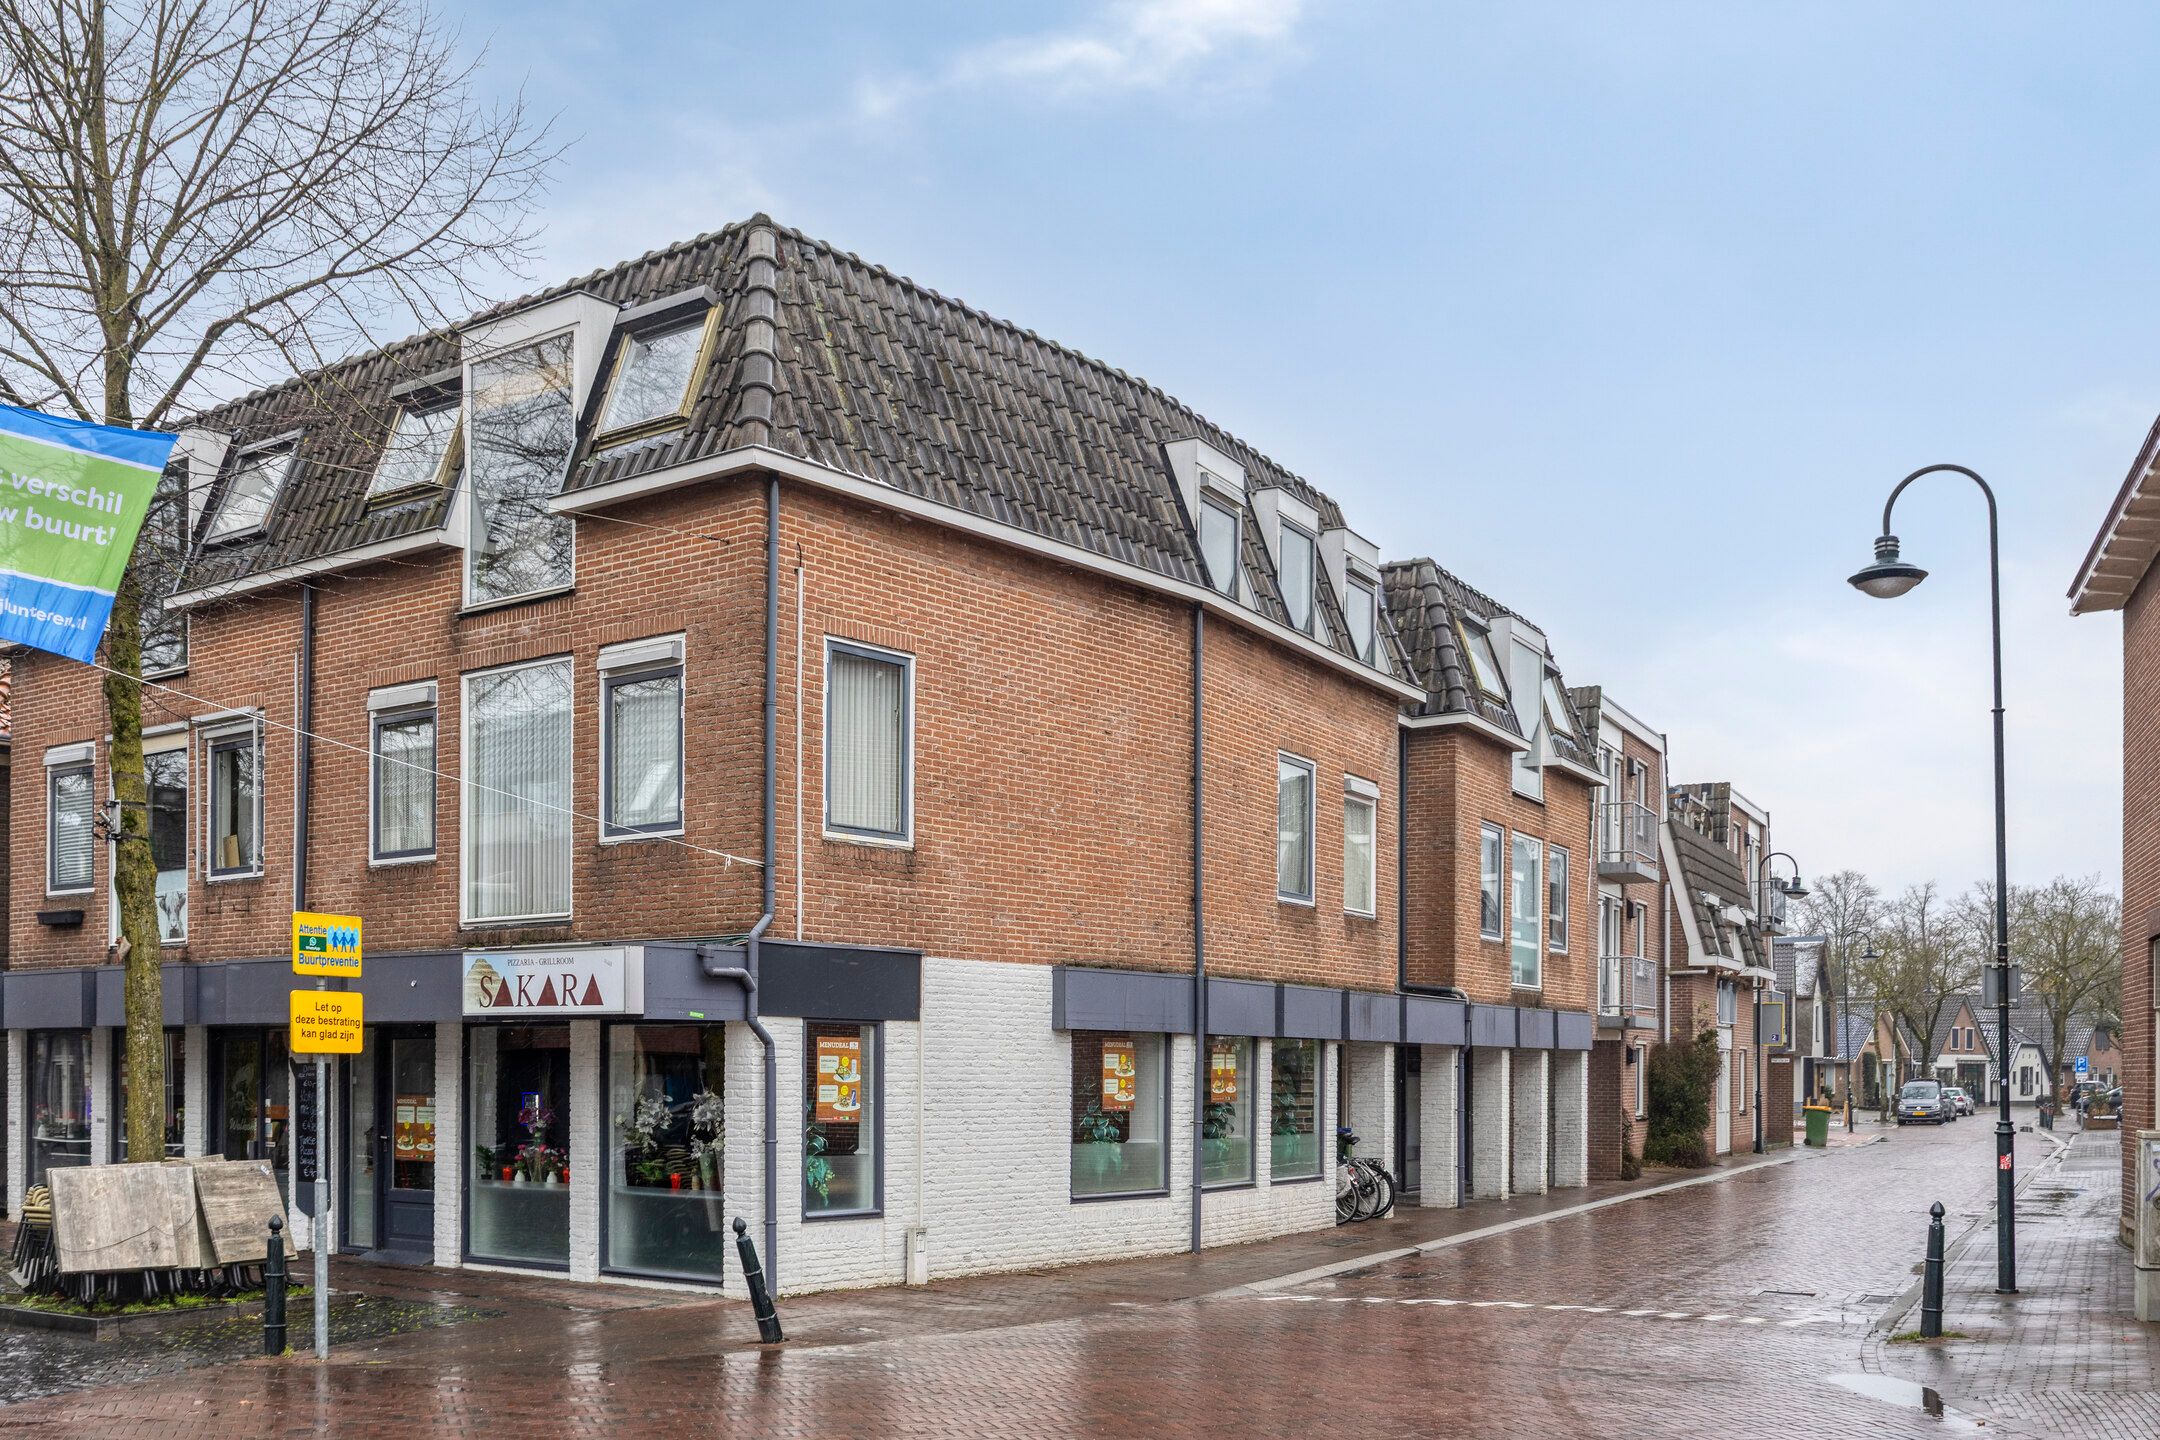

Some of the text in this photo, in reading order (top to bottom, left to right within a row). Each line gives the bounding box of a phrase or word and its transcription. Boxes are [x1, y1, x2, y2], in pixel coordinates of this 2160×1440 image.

[11, 472, 123, 515] verschil
[25, 505, 116, 546] buurt!
[299, 924, 327, 935] Attentie
[299, 953, 359, 967] Buurtpreventie
[538, 957, 575, 966] GRILLROOM
[479, 973, 604, 1008] SAKARA
[315, 1002, 342, 1014] Let op
[295, 1014, 361, 1029] deze bestrating
[301, 1028, 355, 1042] kan glad zijn
